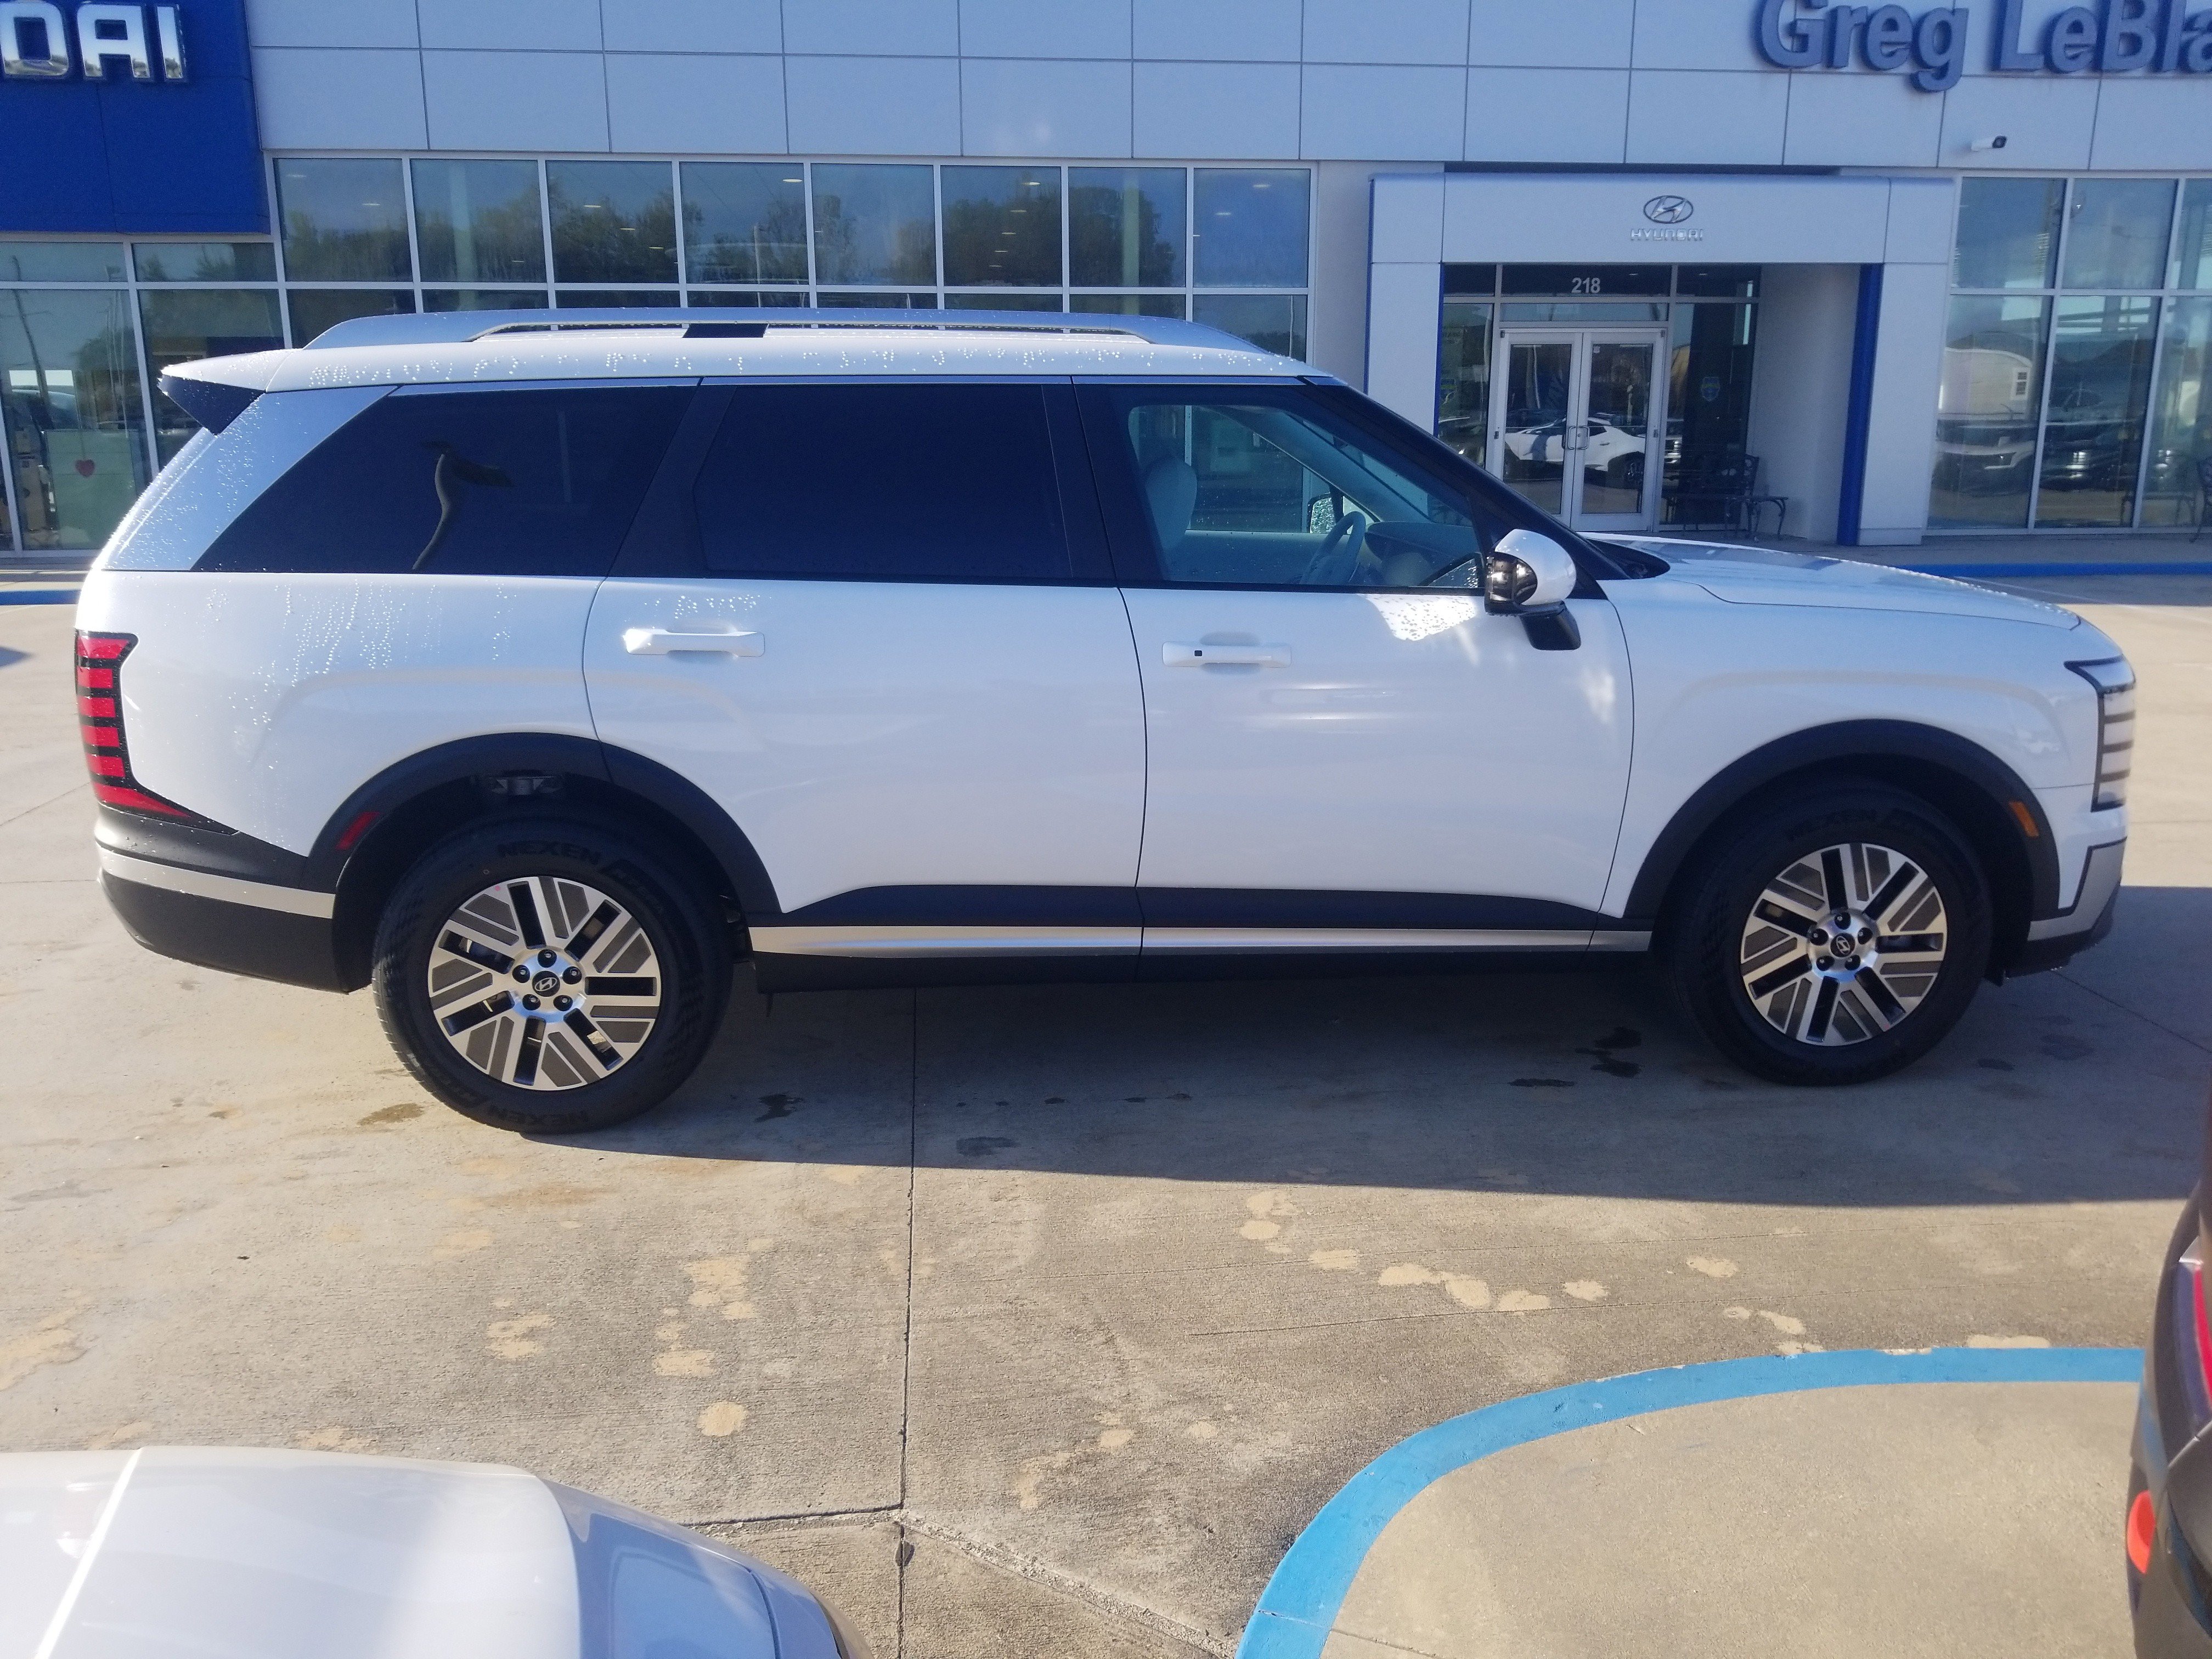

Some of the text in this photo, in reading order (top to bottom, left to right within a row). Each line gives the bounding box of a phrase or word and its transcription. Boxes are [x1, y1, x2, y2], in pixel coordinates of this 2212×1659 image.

[1757, 0, 1970, 93] Greg
[1630, 228, 1703, 241] HYUNDAI
[1571, 277, 1601, 294] 218
[496, 839, 602, 865] NEXEN
